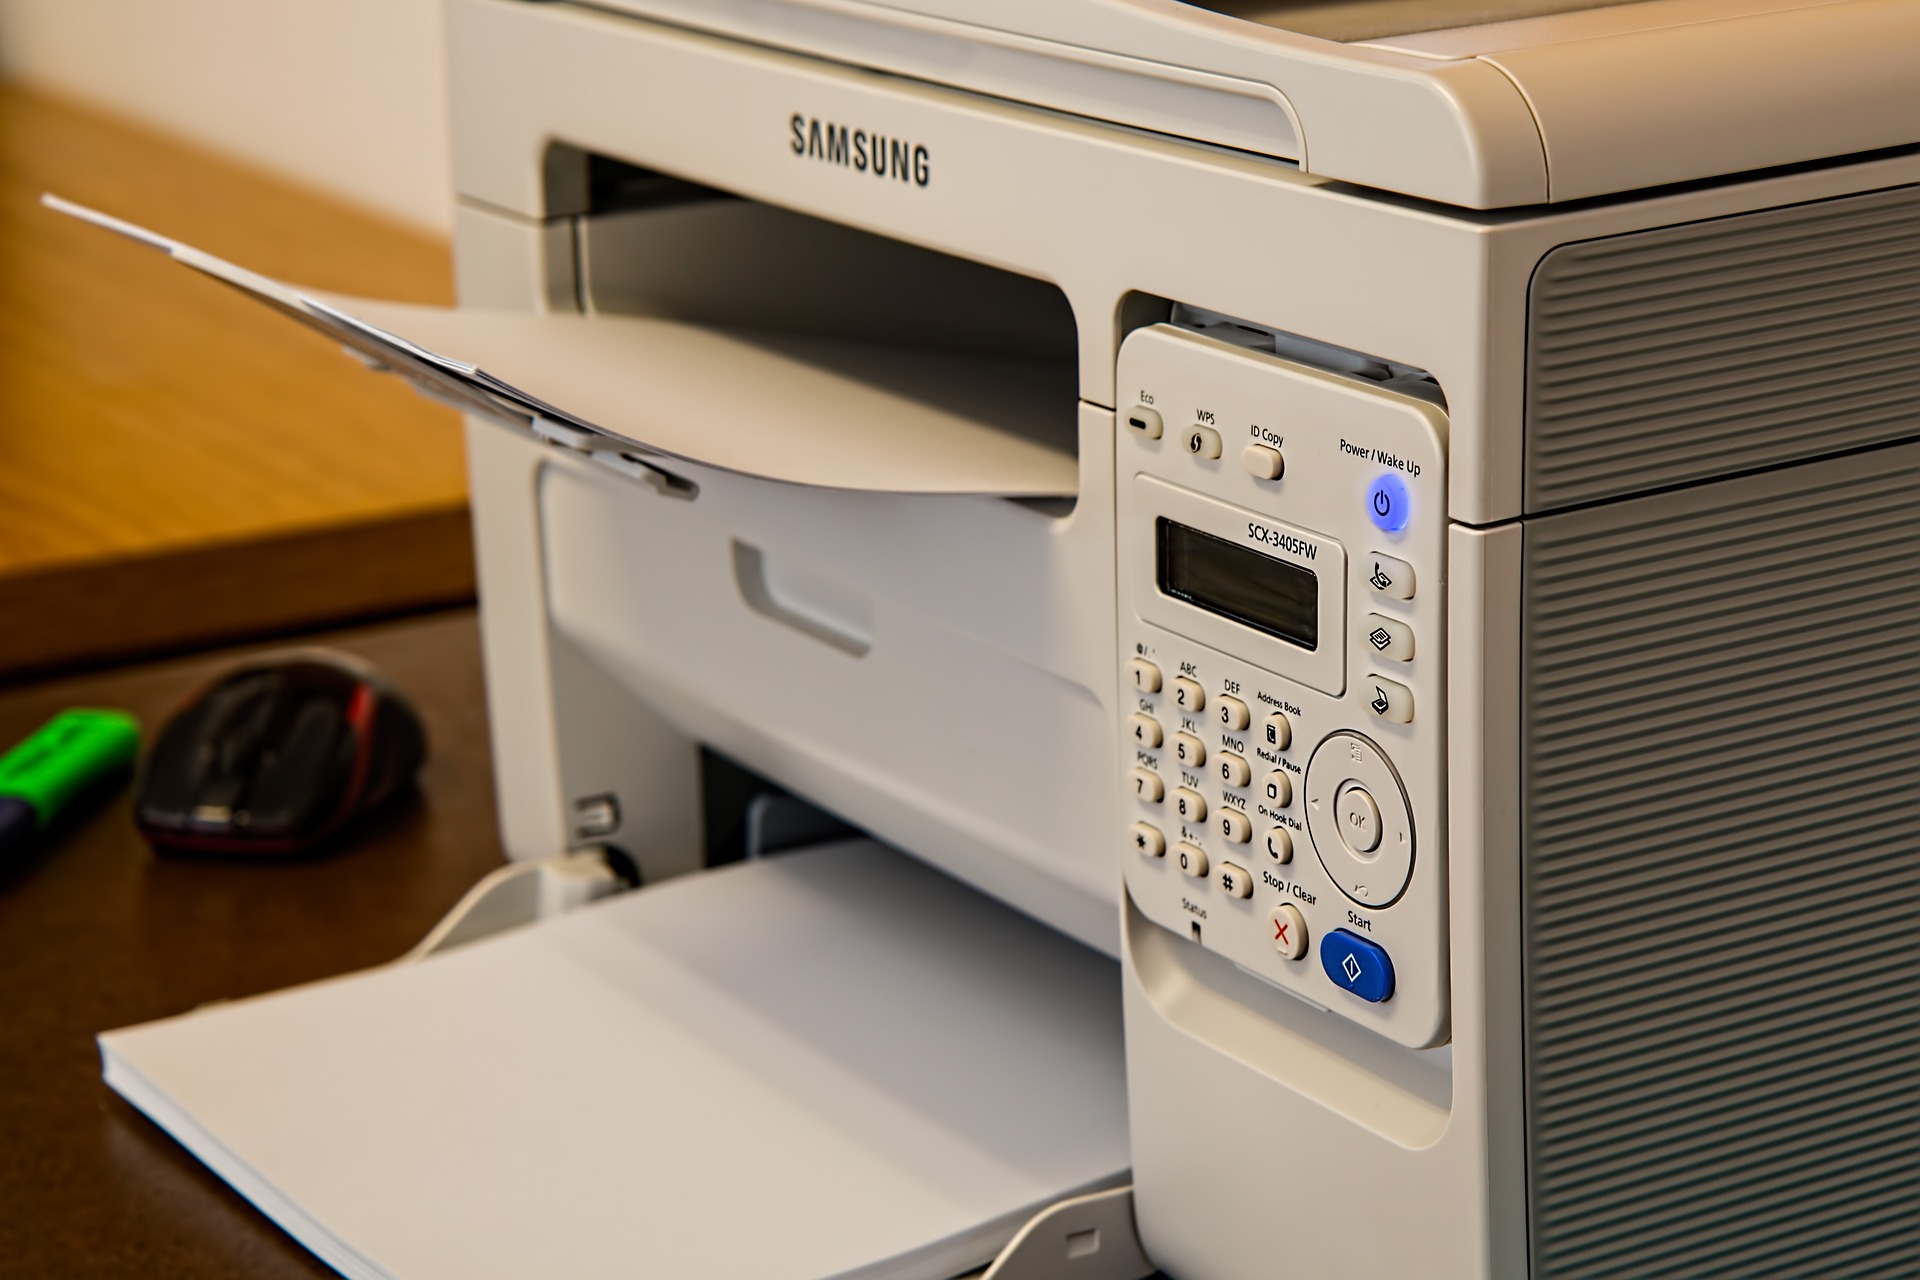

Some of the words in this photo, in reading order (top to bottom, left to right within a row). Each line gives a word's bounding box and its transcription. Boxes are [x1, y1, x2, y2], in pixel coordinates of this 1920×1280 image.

[790, 112, 930, 188] SAMSUNG
[1140, 390, 1154, 404] Eco
[1197, 409, 1215, 425] WPS
[1250, 425, 1260, 438] ID
[1262, 428, 1284, 448] Copy
[1340, 439, 1370, 461] Power
[1376, 451, 1405, 470] Wake
[1406, 461, 1421, 477] Up
[1248, 522, 1318, 560] SCX-3405FW
[1136, 670, 1141, 685] 1
[1180, 661, 1197, 678] ABC
[1224, 679, 1240, 694] DEF
[1177, 688, 1185, 705] 2
[1257, 691, 1283, 709] Address
[1284, 701, 1302, 717] Book
[1139, 699, 1154, 714] GHI
[1221, 706, 1229, 723] 3
[1135, 725, 1142, 740] 4
[1181, 717, 1197, 733] JKL
[1178, 743, 1185, 759] 5
[1222, 735, 1244, 753] MNO
[1137, 751, 1158, 769] PQRS
[1256, 747, 1277, 764] Redial
[1282, 757, 1302, 775] Pause
[1182, 771, 1199, 788] TUV
[1222, 763, 1229, 779] 6
[1136, 778, 1143, 794] 7
[1179, 799, 1186, 815] 8
[1223, 790, 1246, 810] WXYZ
[1258, 804, 1268, 817] On
[1269, 809, 1287, 825] Hook
[1288, 817, 1302, 832] Dial
[1350, 812, 1366, 831] OK
[1223, 819, 1230, 836] 9
[1180, 853, 1188, 870] 0
[1222, 874, 1233, 892] #
[1263, 871, 1285, 893] Stop
[1292, 884, 1317, 906] Clear
[1182, 898, 1207, 919] Status
[1347, 910, 1372, 932] Start
